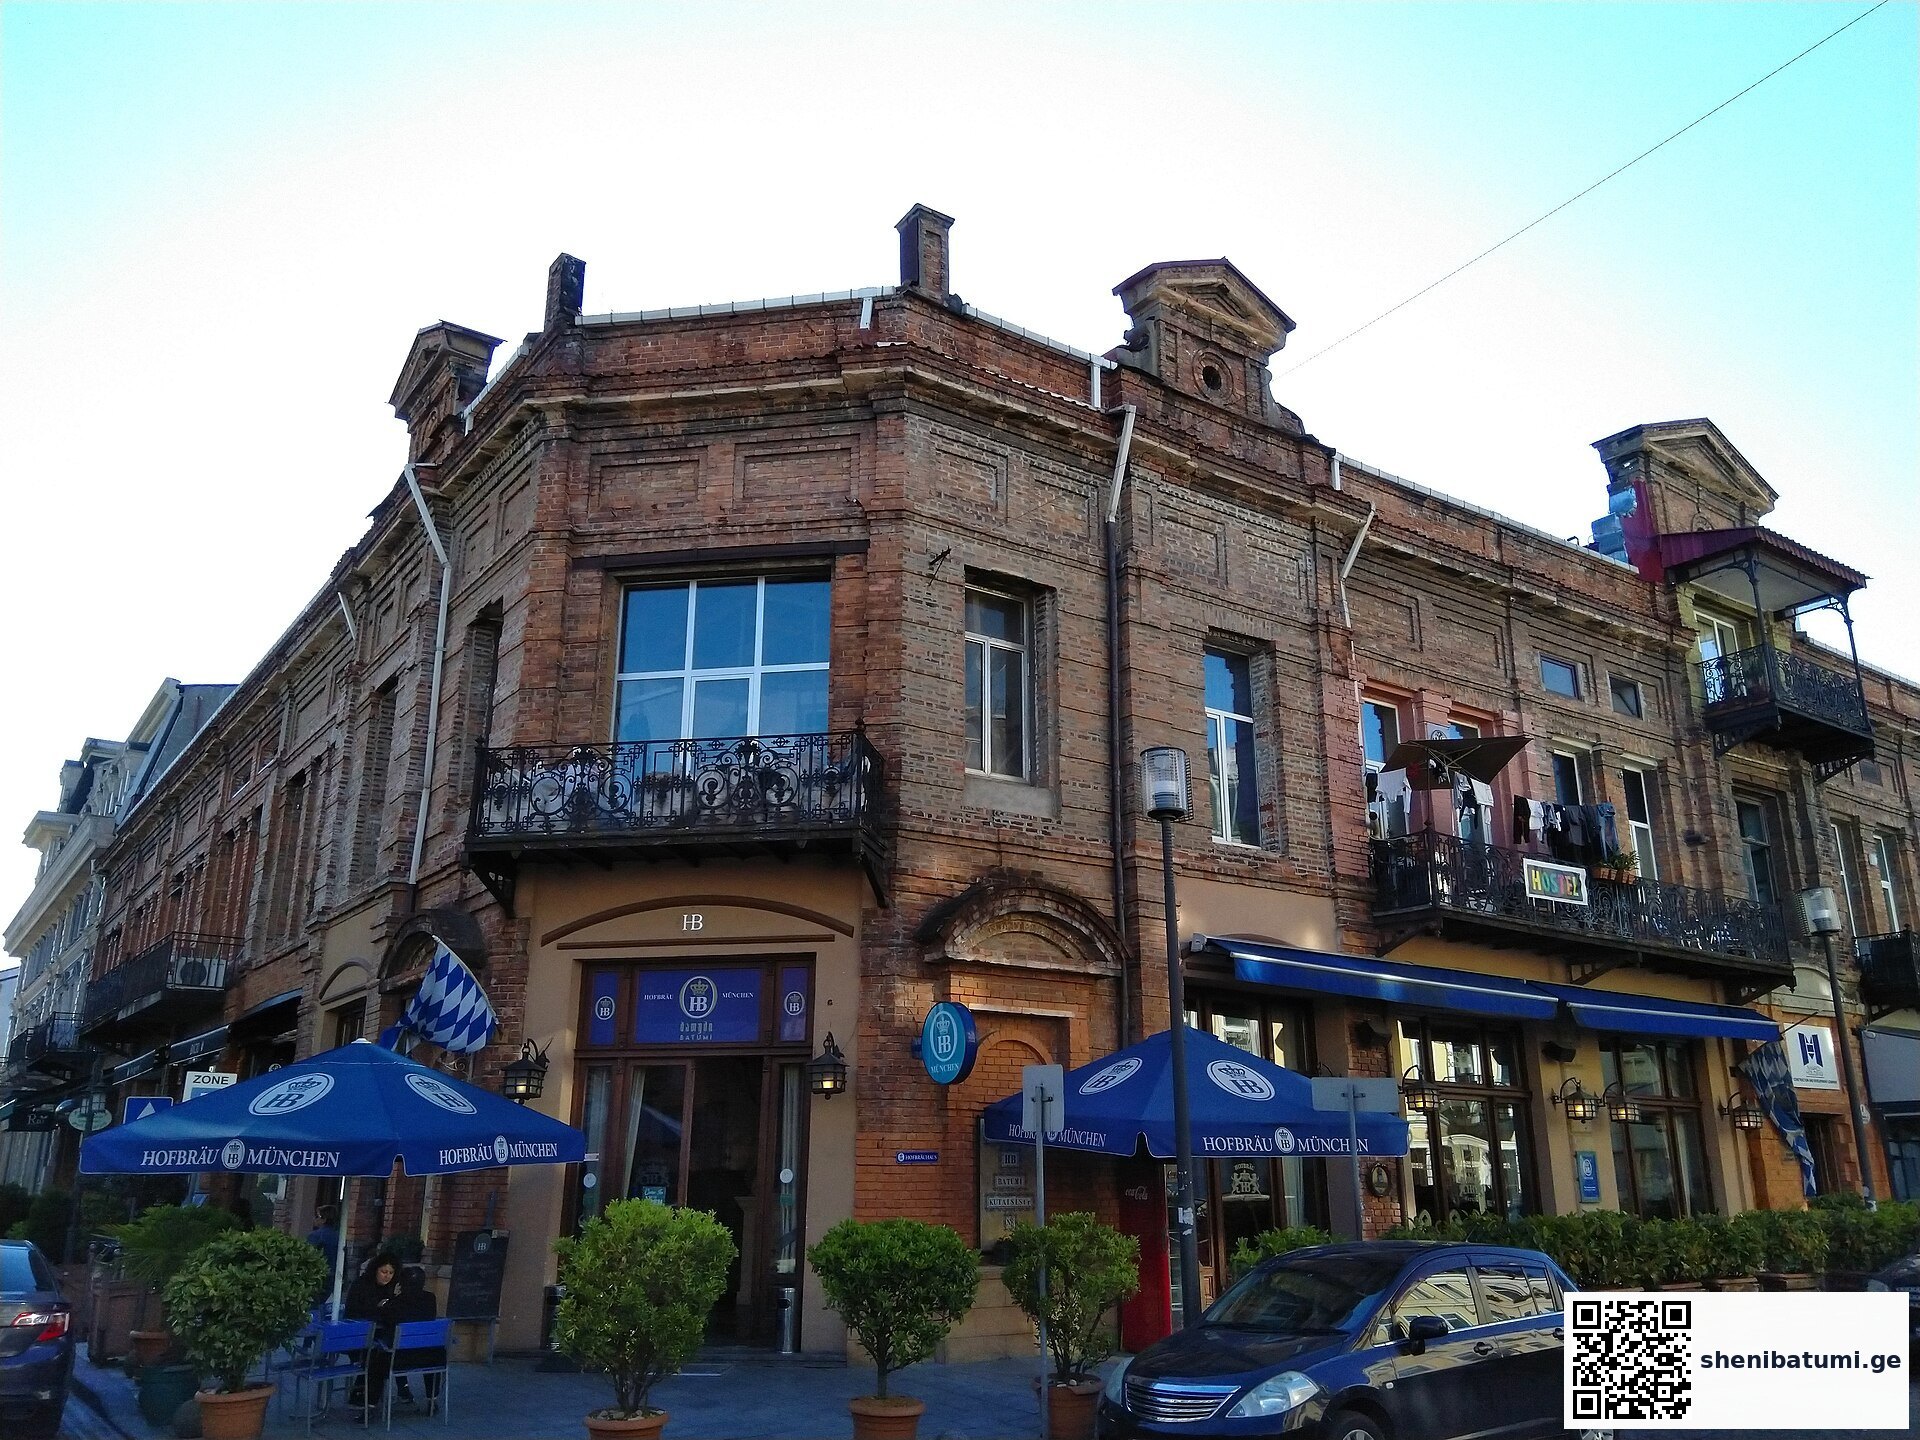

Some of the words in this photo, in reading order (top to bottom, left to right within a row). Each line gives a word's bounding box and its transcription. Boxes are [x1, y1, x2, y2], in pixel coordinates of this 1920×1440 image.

[1531, 869, 1580, 897] HOSTEL
[682, 913, 704, 931] HB
[644, 992, 674, 1000] HOFBRÄU
[689, 996, 708, 1012] HB
[722, 991, 754, 999] MÜNCHEN
[937, 1035, 952, 1054] HB
[930, 1063, 960, 1074] MÜNCHEN
[192, 1074, 230, 1085] ZONE
[1202, 1134, 1273, 1152] HOFBRÄU
[1297, 1135, 1369, 1152] MÜNCHN
[140, 1145, 220, 1166] HOFBRÄU
[247, 1146, 341, 1168] MÜNCHEN
[439, 1143, 493, 1166] HOFBRÄU
[508, 1140, 558, 1158] MÜNCHEN
